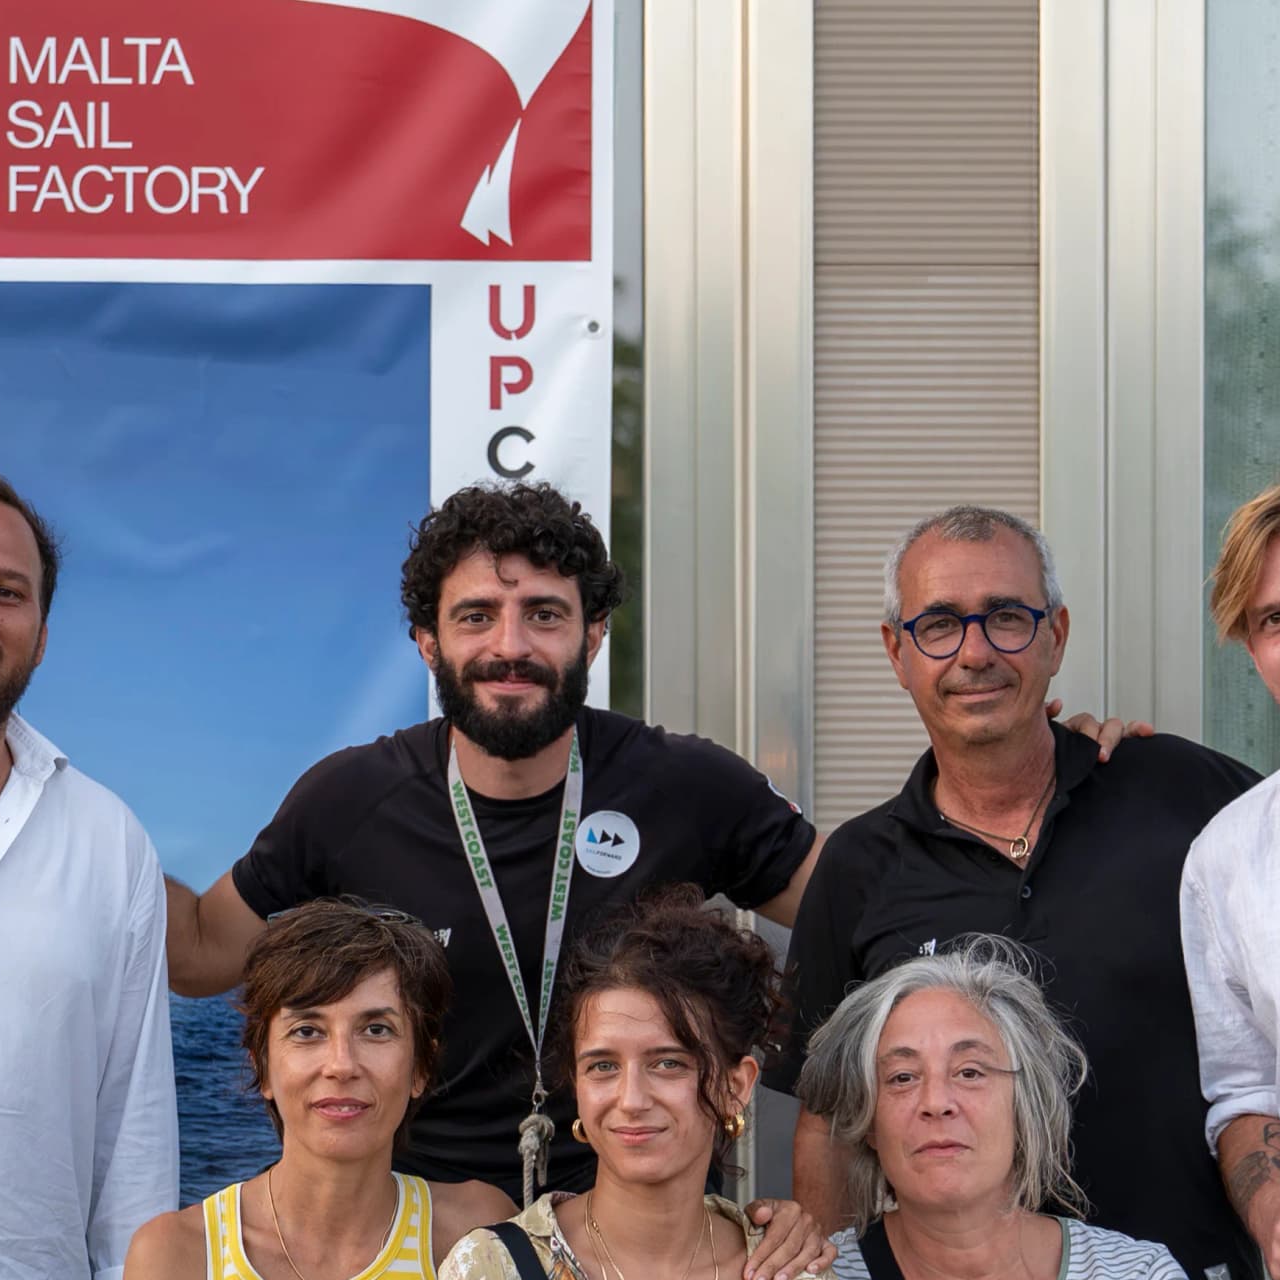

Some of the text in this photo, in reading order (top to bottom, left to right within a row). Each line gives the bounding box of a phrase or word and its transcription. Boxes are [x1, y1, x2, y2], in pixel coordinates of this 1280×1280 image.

[7, 36, 195, 86] MALTA
[6, 101, 133, 150] SAIL
[7, 165, 266, 215] FACTORY
[451, 780, 493, 889] WEST COAST
[550, 809, 578, 922] WEST COAST
[495, 924, 517, 970] WEST
